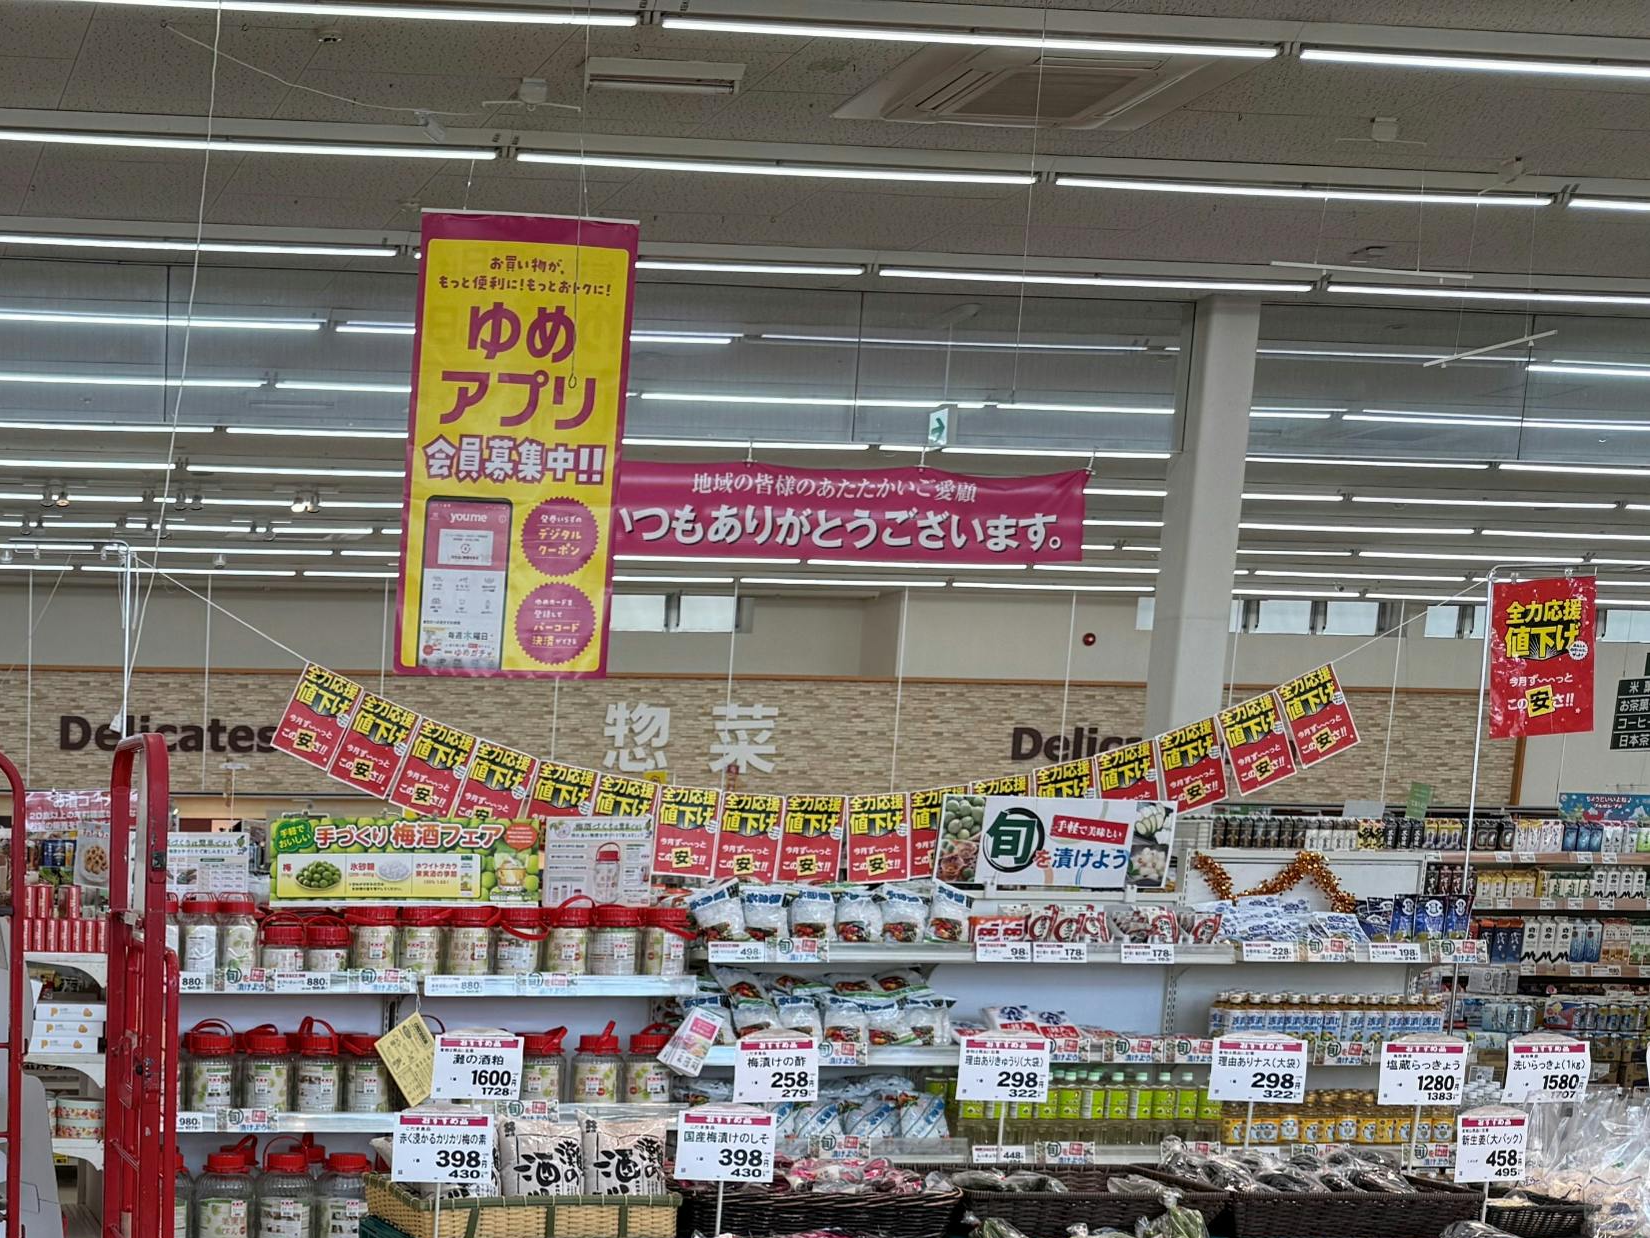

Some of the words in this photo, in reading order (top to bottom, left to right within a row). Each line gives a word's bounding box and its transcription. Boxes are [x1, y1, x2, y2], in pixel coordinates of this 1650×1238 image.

[467, 301, 577, 362] ゆめ
[439, 369, 596, 430] アプリ
[423, 435, 605, 486] 会員募集中!!
[692, 473, 977, 503] 地域の皆様のあたたかいご愛顧
[450, 512, 487, 523] youme
[538, 528, 582, 540] デジタル
[538, 544, 580, 556] クーポン
[1506, 599, 1582, 624] 全力応援
[533, 622, 580, 632] バーコード
[1505, 622, 1581, 658] 値下げ
[305, 664, 359, 700] 全力応援
[1280, 667, 1331, 700] 全力応援
[297, 681, 352, 716] 値下げ
[1286, 681, 1335, 720] 値下げ
[1507, 685, 1574, 717] この安さ!!
[1620, 699, 1650, 712] お茶菓
[1619, 734, 1650, 747] 日本茶
[476, 743, 531, 772] 全力応援
[1099, 743, 1150, 766] 全力応援
[470, 759, 526, 790] 値下げ
[1101, 763, 1150, 791] 値下げ
[662, 786, 716, 806] 全力応援
[850, 795, 903, 811] 全力応援
[659, 804, 714, 825] 値下げ
[850, 811, 903, 834] 値下げ
[278, 833, 311, 849] おいしい
[986, 811, 1039, 865] 旬
[471, 1070, 510, 1086] 1600
[771, 1071, 808, 1088] 258
[998, 1071, 1038, 1087] 298
[1251, 1072, 1294, 1088] 298
[1417, 1075, 1454, 1091] 1280
[1543, 1075, 1579, 1090] 1580
[482, 1087, 509, 1096] 1728
[1009, 1089, 1037, 1098] 322
[436, 1150, 480, 1168] 398
[719, 1149, 763, 1166] 398
[1486, 1150, 1517, 1167] 458
[449, 1170, 480, 1179] 430
